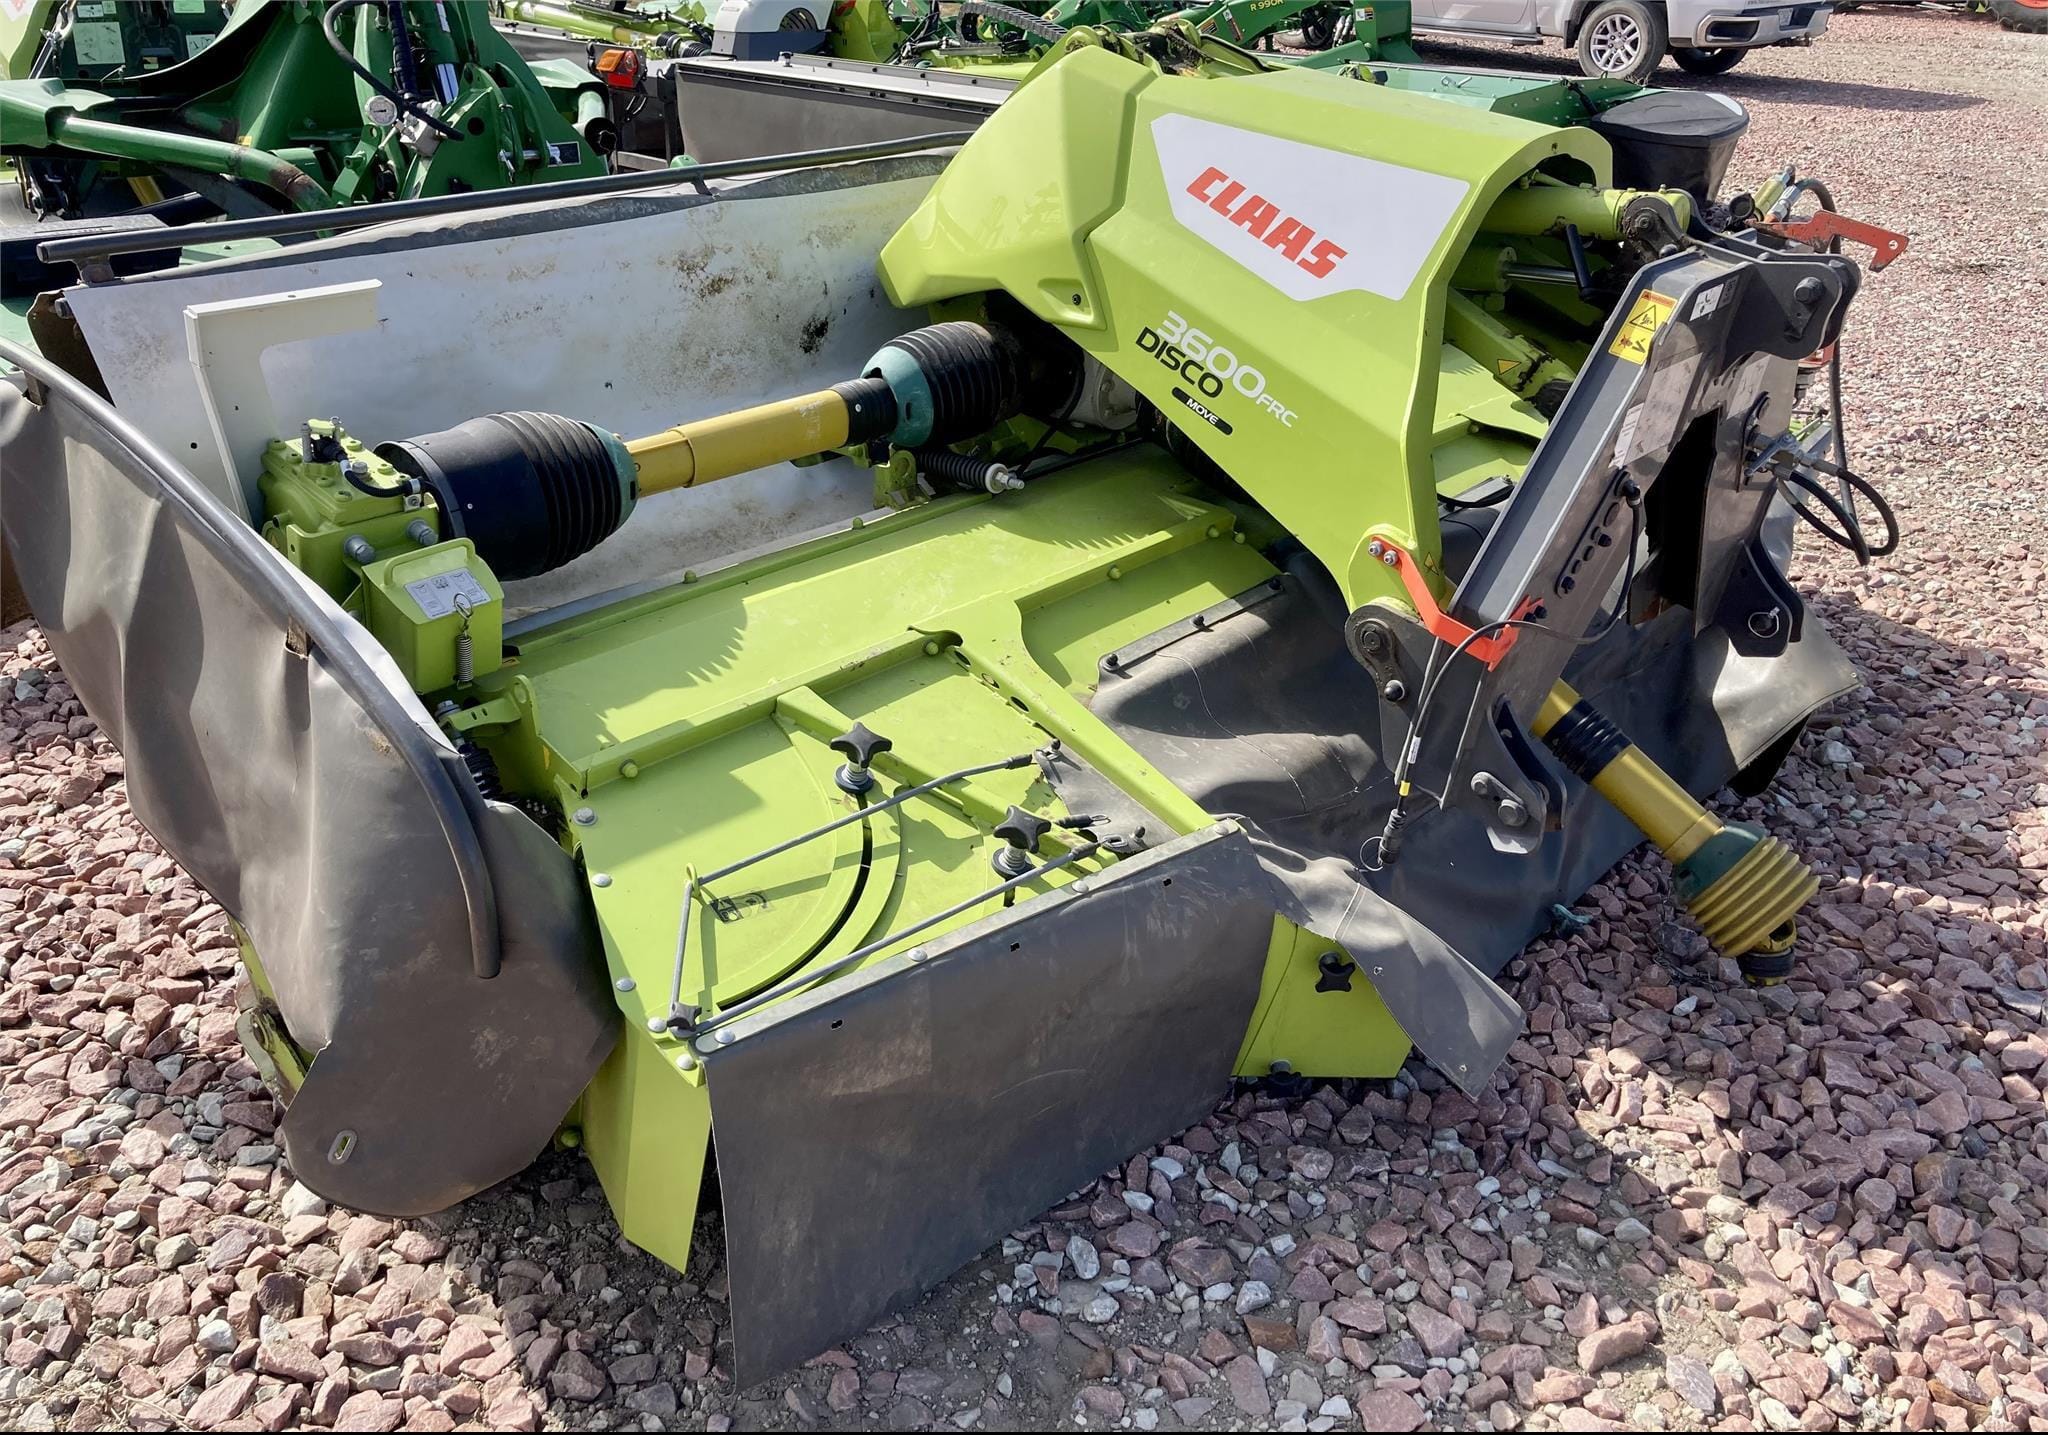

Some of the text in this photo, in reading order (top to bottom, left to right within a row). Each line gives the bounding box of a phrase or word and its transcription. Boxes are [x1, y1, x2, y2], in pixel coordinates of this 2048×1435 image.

[1250, 3, 1257, 11] R
[1186, 166, 1348, 279] CLAAS
[1136, 326, 1223, 398] DISCO
[1186, 398, 1219, 425] MOVE
